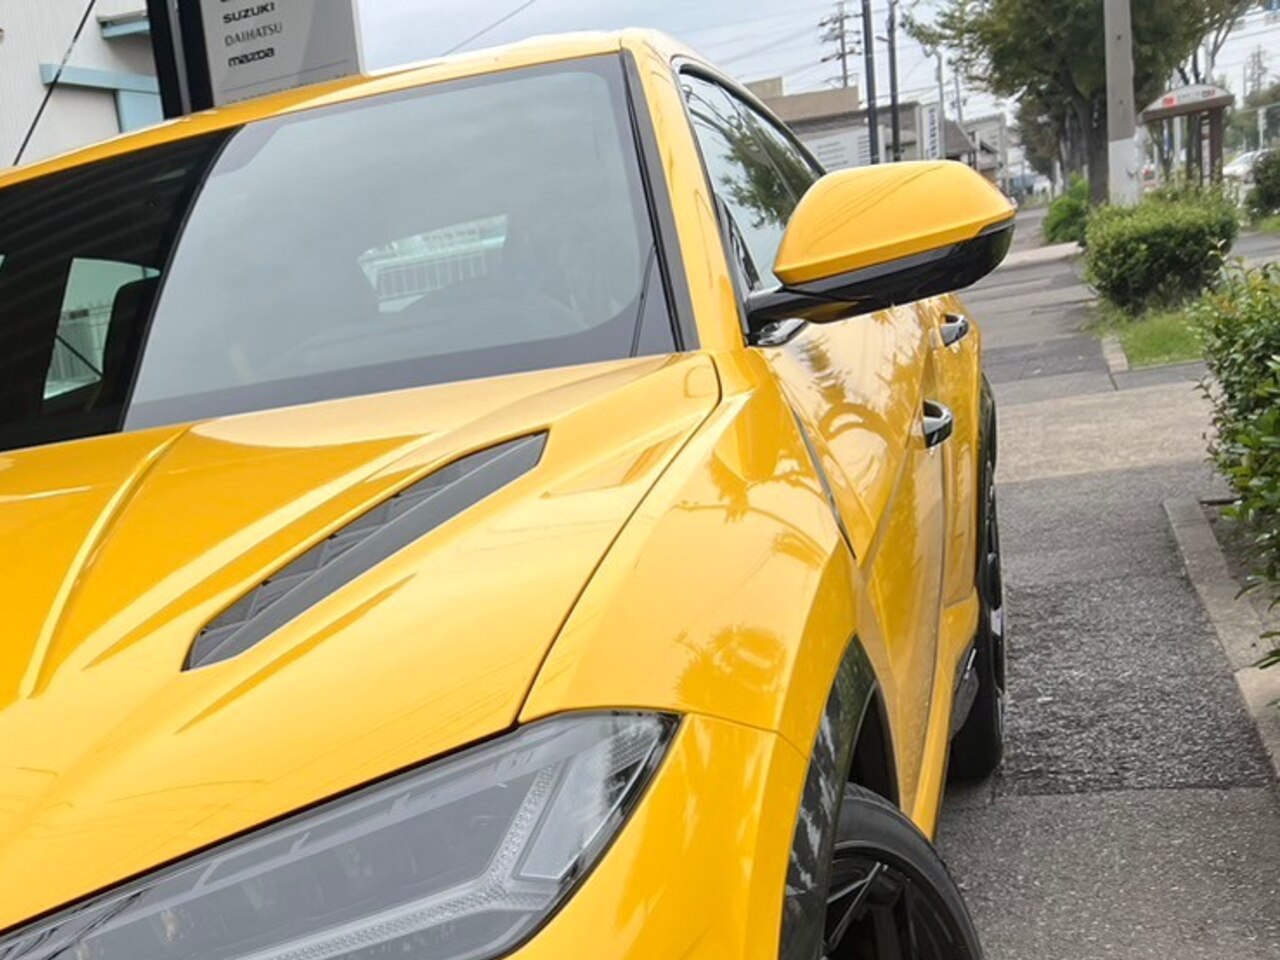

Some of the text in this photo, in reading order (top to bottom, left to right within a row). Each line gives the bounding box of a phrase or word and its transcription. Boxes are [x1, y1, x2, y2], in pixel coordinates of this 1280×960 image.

[223, 2, 275, 24] SUZUKI
[224, 22, 282, 47] DAIHATSU
[227, 48, 274, 67] mazda
